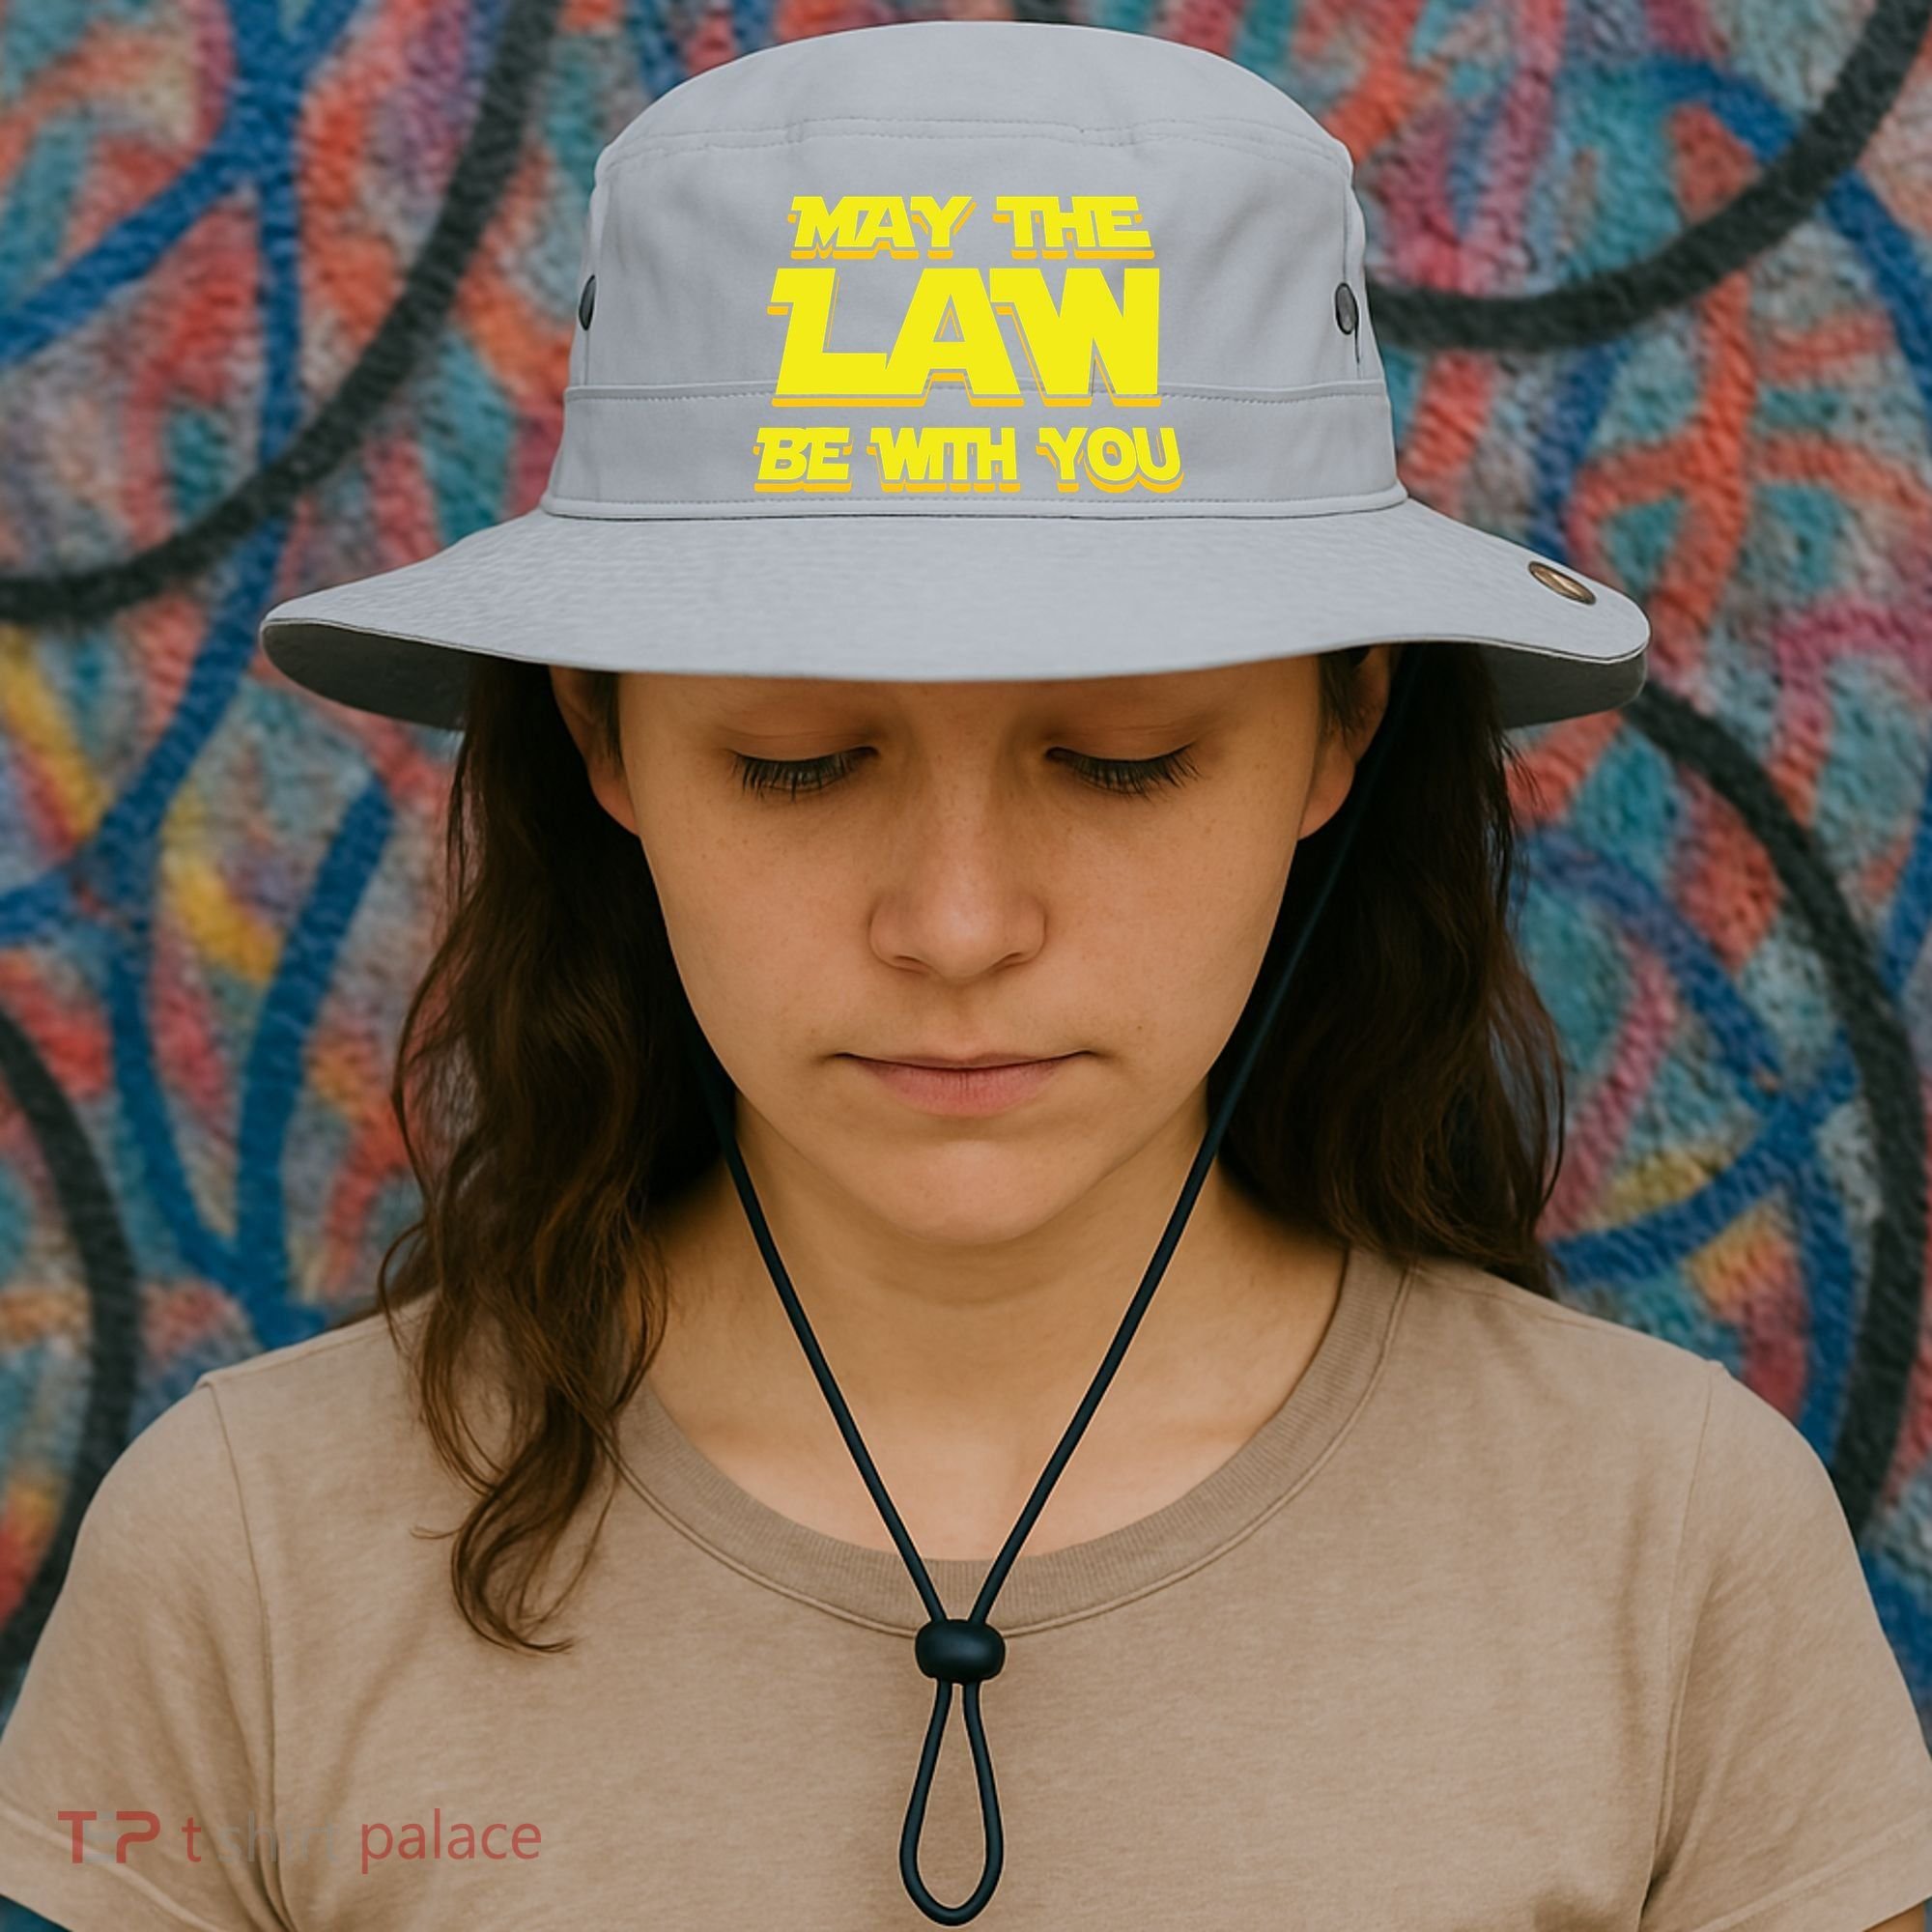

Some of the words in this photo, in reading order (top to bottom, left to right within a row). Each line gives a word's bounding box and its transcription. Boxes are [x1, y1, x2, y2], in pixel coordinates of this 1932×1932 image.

[788, 196, 977, 259] MAY
[993, 196, 1154, 259] THE
[768, 268, 1161, 407] LAW
[753, 427, 852, 493] BE
[867, 427, 1021, 493] WITH
[1037, 427, 1184, 493] YOU
